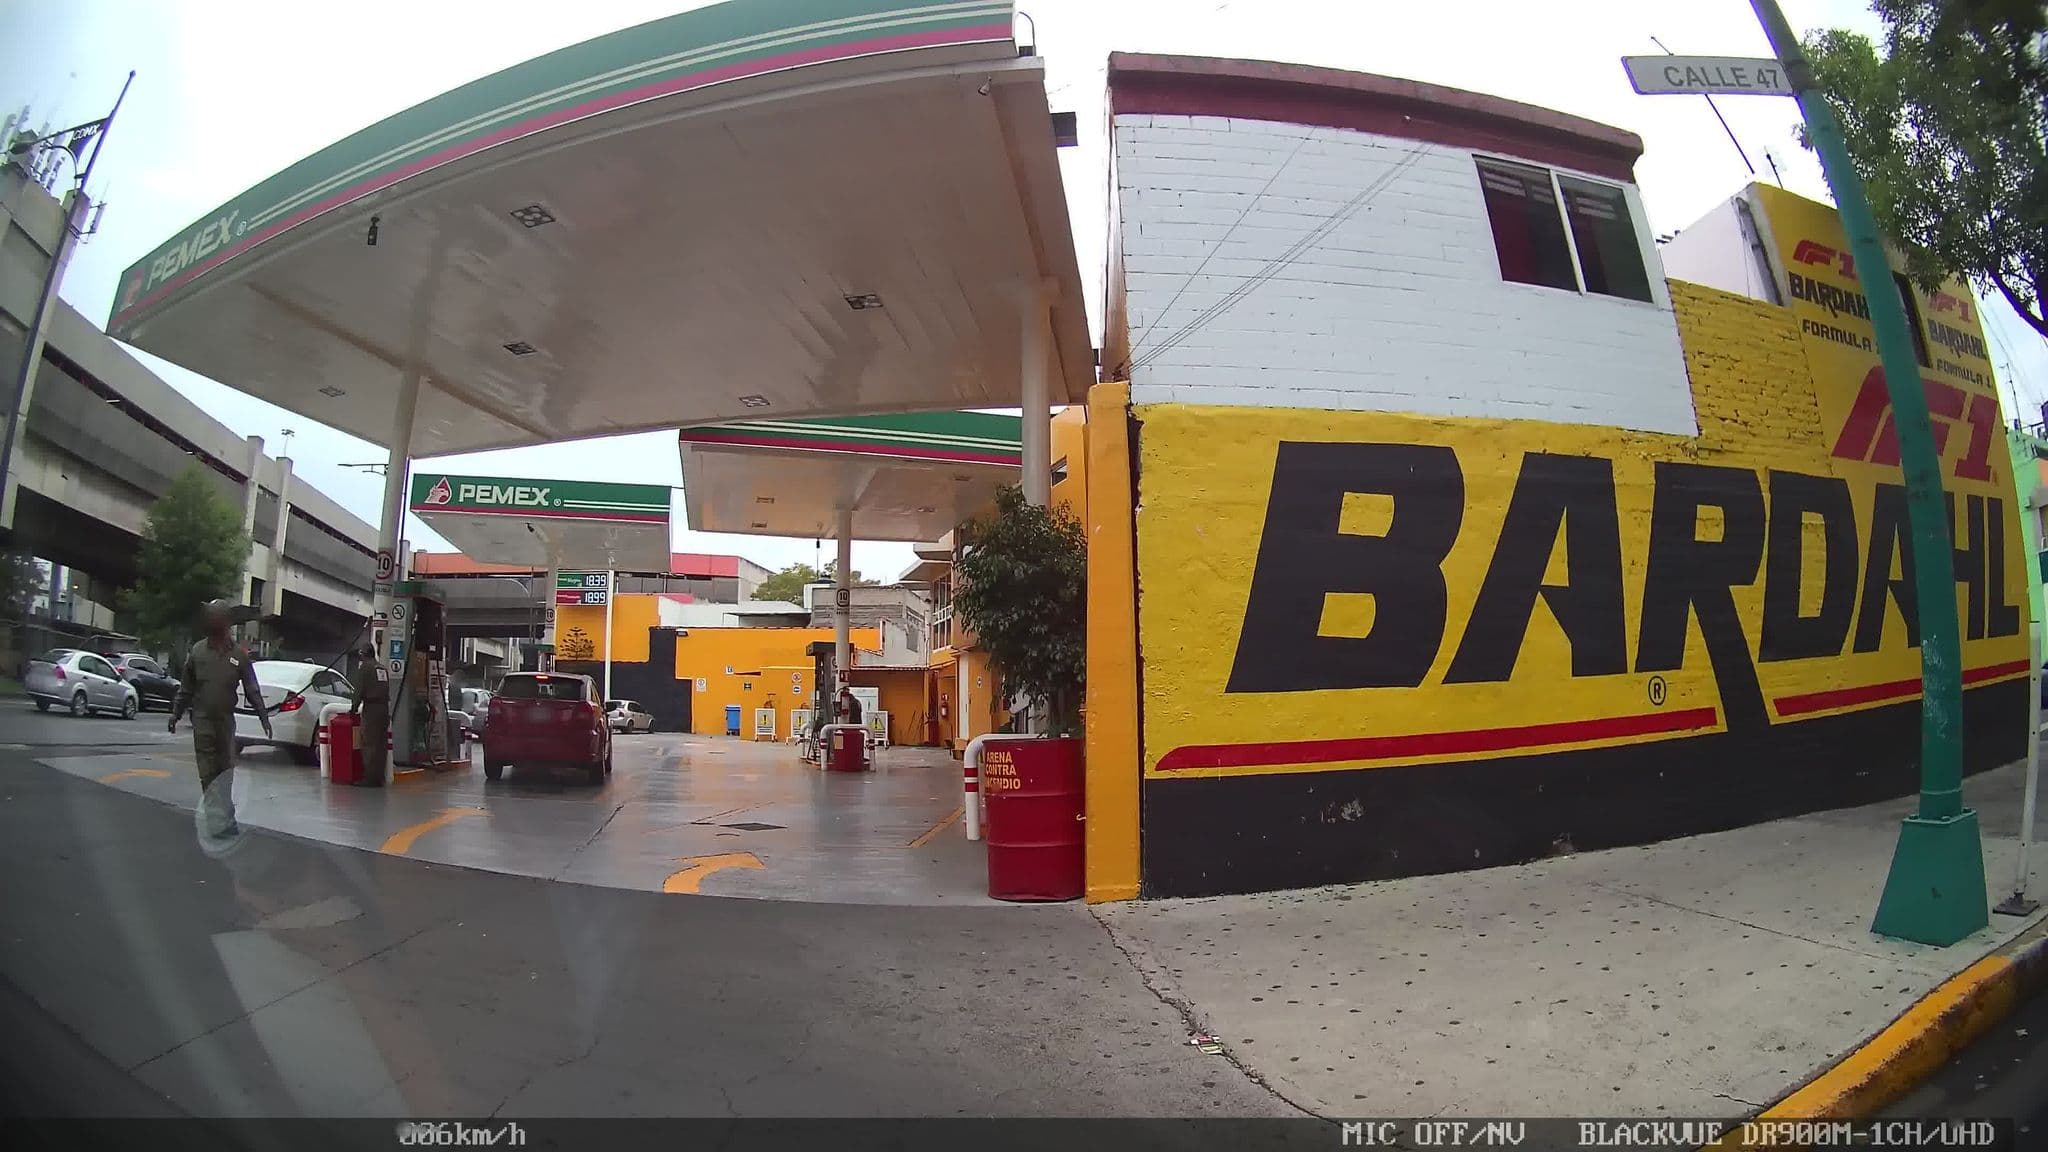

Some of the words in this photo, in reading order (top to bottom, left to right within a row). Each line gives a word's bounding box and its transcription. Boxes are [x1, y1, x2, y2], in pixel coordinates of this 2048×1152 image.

[1663, 65, 1752, 88] CALLE
[1756, 68, 1779, 89] 47
[146, 209, 240, 291] PEMEX
[1788, 271, 1871, 321] BARDAH
[1802, 318, 1872, 353] FORMULA
[1937, 358, 1984, 387] FORMULA
[458, 484, 550, 506] PEMEX
[378, 557, 391, 571] 10
[839, 591, 848, 601] 10
[1225, 440, 2020, 733] BARDAHL
[986, 751, 1013, 764] ARENA
[985, 764, 1017, 776] CONTRA
